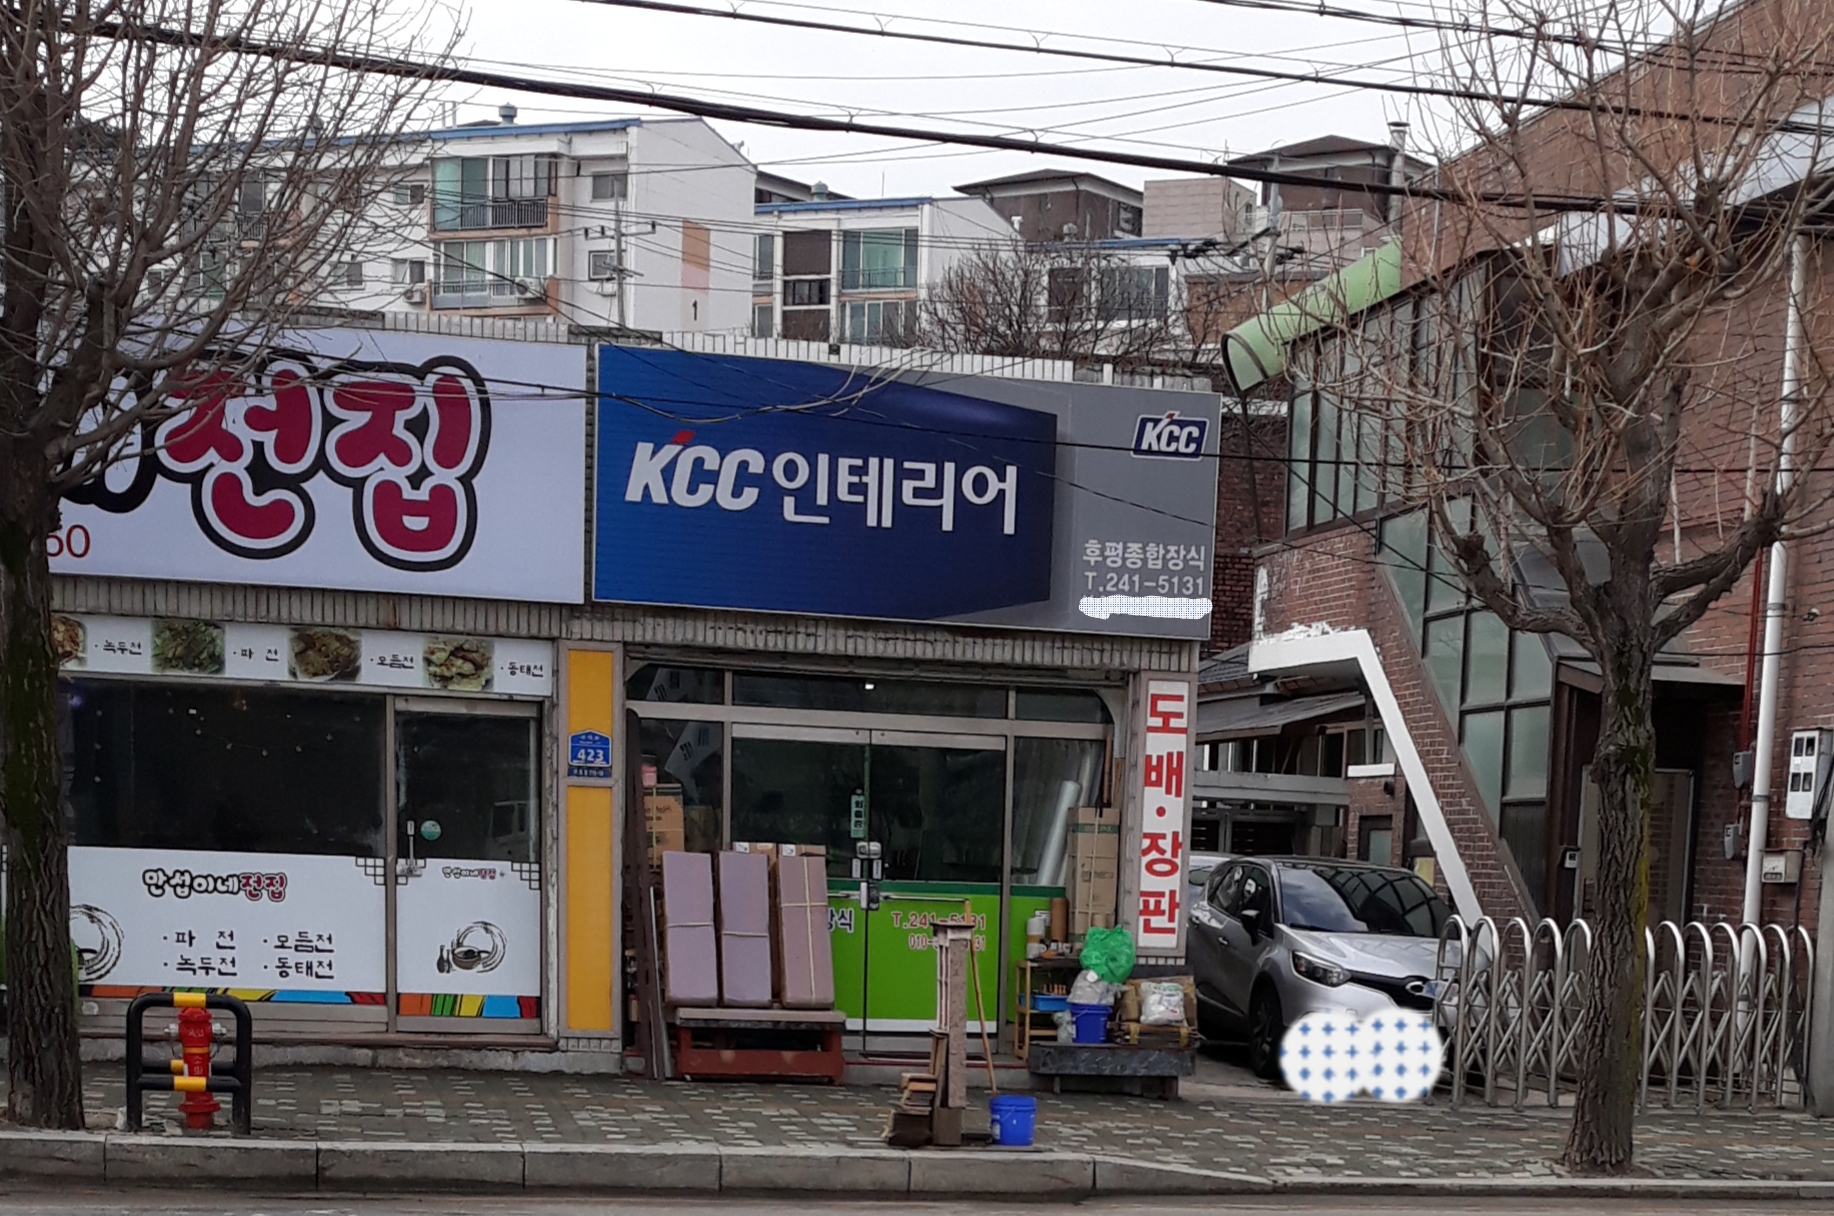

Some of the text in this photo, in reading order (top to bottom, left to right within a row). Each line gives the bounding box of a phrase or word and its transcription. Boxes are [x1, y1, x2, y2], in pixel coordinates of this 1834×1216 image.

[1141, 411, 1200, 453] KCC
[1082, 539, 1206, 571] 후평종합장식
[103, 639, 142, 655] 녹두전
[508, 662, 544, 678] 동태전
[577, 749, 605, 763] 423
[273, 930, 335, 954] 모듬전
[176, 954, 238, 977] 녹두전
[274, 956, 335, 980] 동태전
